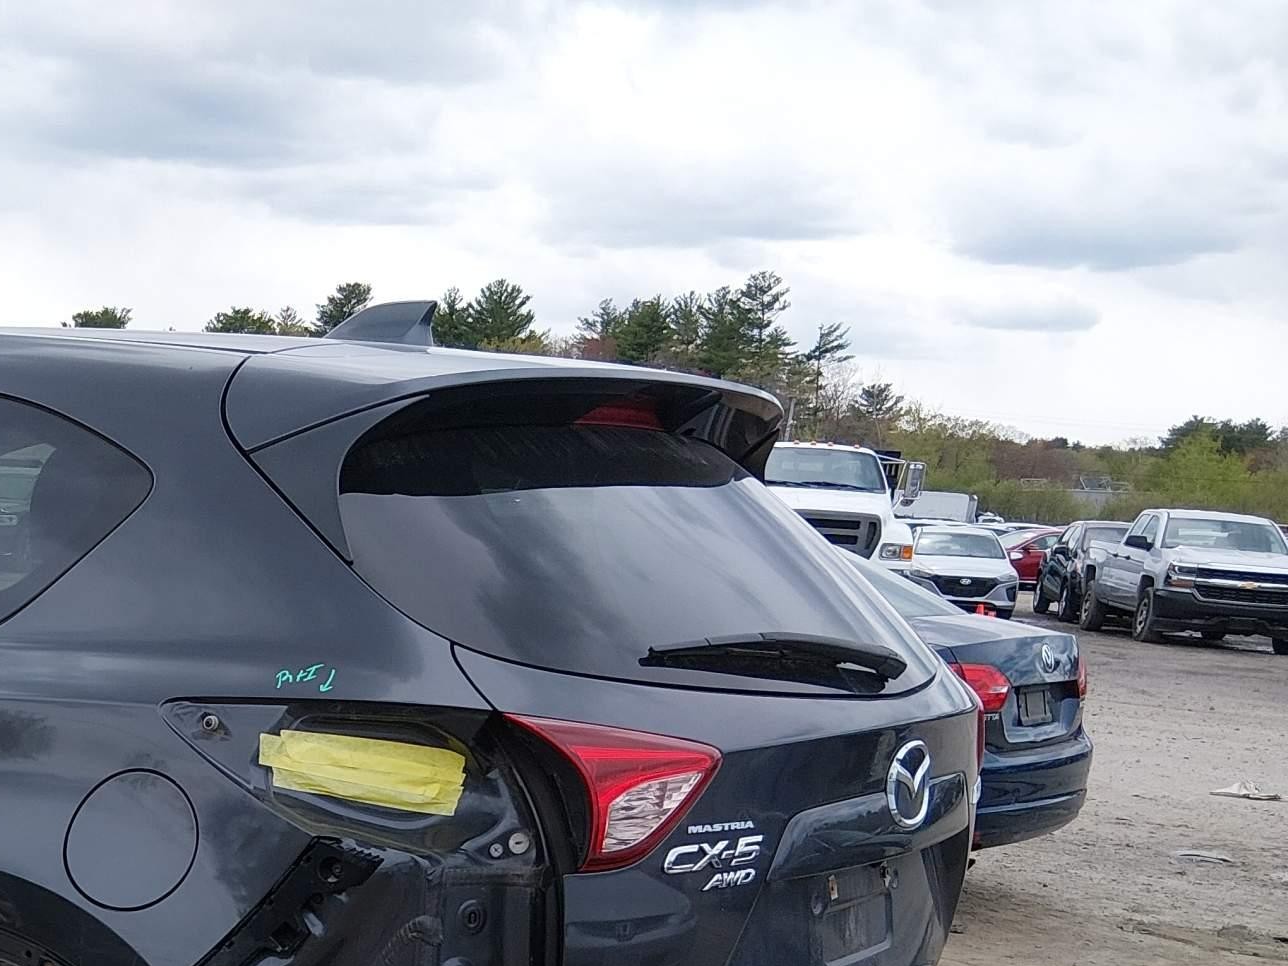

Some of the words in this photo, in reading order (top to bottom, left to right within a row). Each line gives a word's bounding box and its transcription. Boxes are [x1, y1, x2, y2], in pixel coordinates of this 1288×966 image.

[687, 820, 754, 834] MASTRIA
[664, 834, 764, 875] CX-5
[701, 868, 756, 892] AWD
